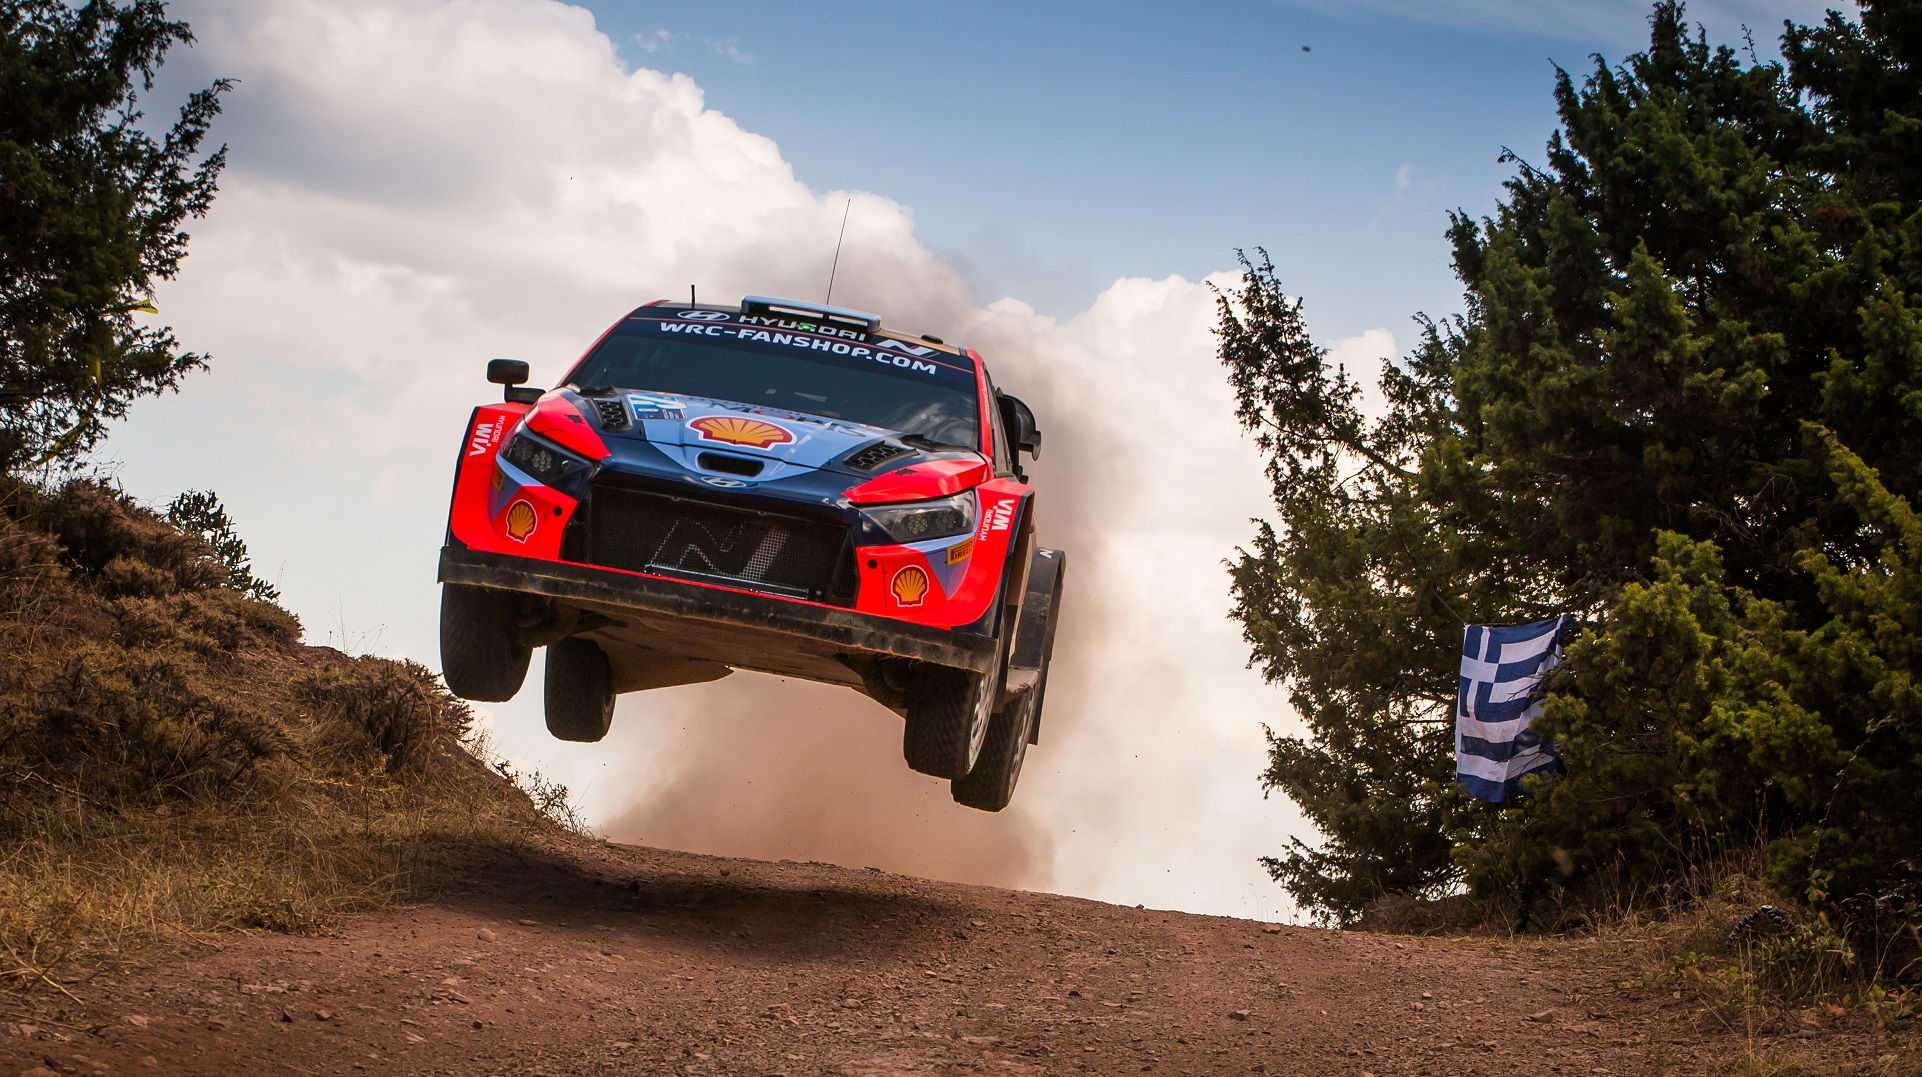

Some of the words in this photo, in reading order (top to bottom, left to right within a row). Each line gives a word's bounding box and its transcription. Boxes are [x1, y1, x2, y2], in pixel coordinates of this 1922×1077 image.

[739, 315, 867, 341] HYUNDAI
[660, 322, 937, 375] WRC-FANSHOP.COM
[492, 415, 506, 443] HYUNDAI
[979, 509, 994, 541] HYUNDAI
